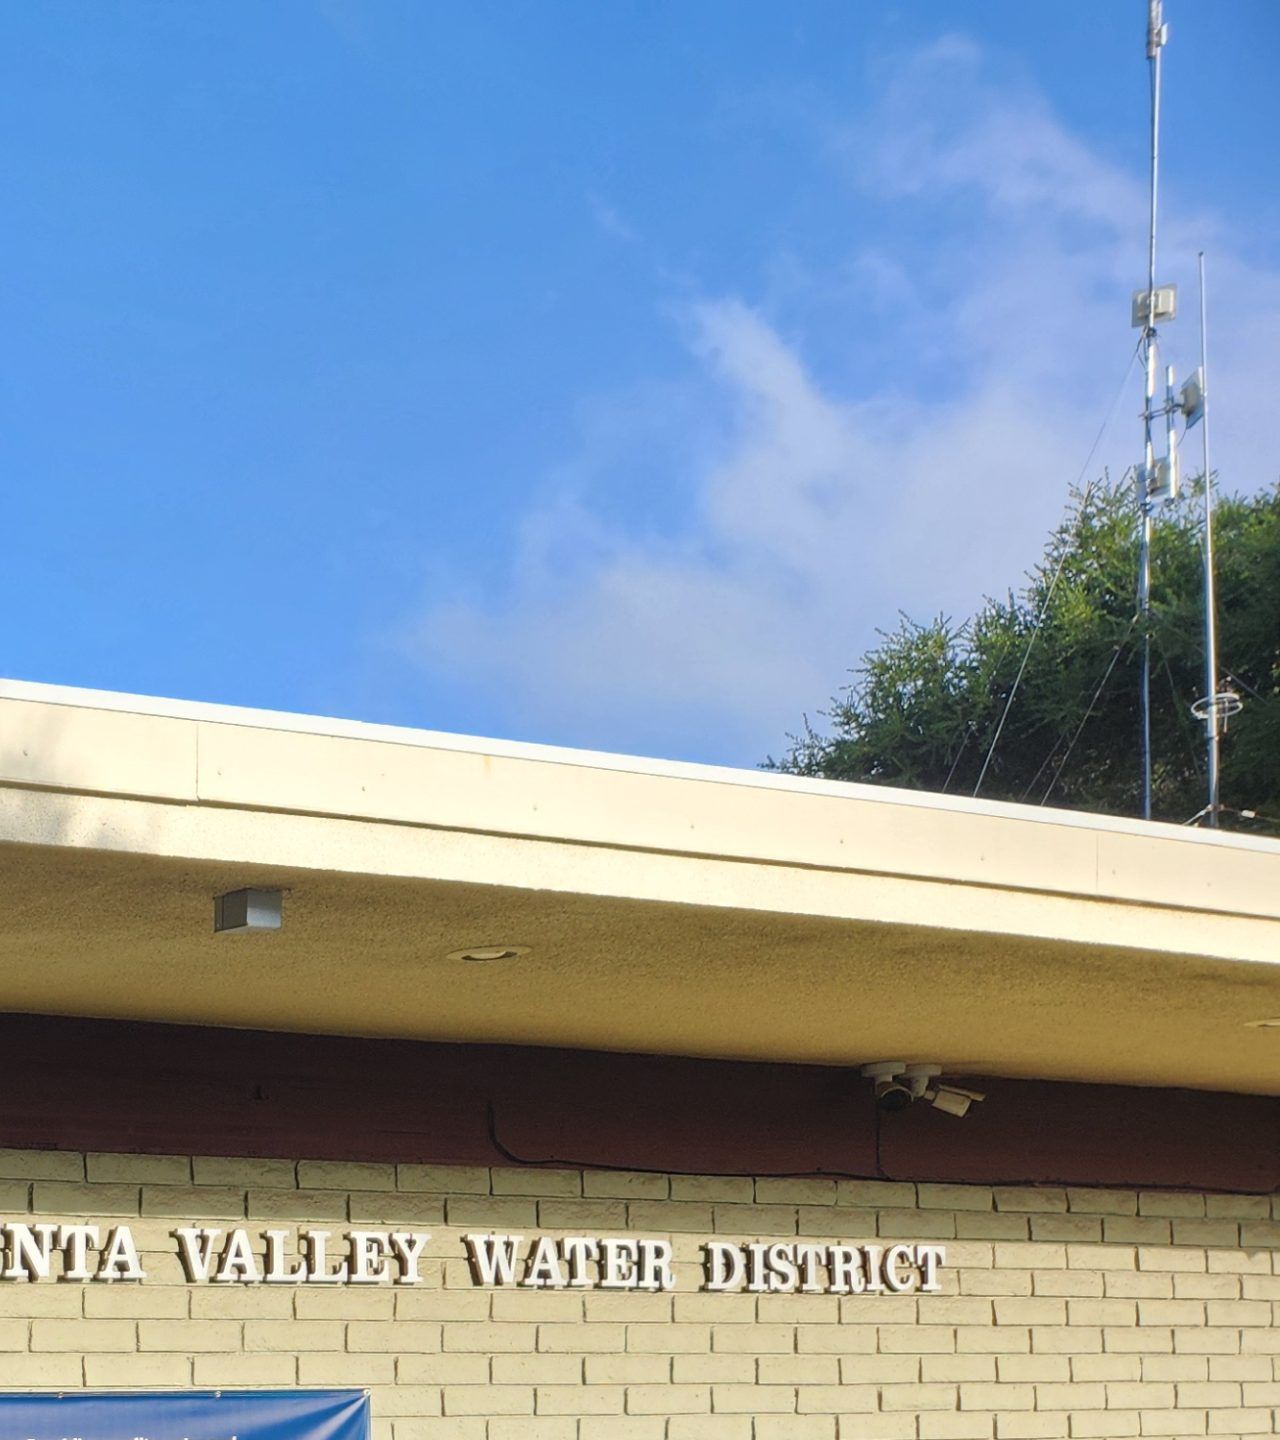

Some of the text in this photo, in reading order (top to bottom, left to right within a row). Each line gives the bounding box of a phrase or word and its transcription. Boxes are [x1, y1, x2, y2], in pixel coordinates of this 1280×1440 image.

[175, 1227, 432, 1284] VALLEY
[467, 1233, 676, 1290] WATER
[706, 1241, 946, 1294] DISTRICT
